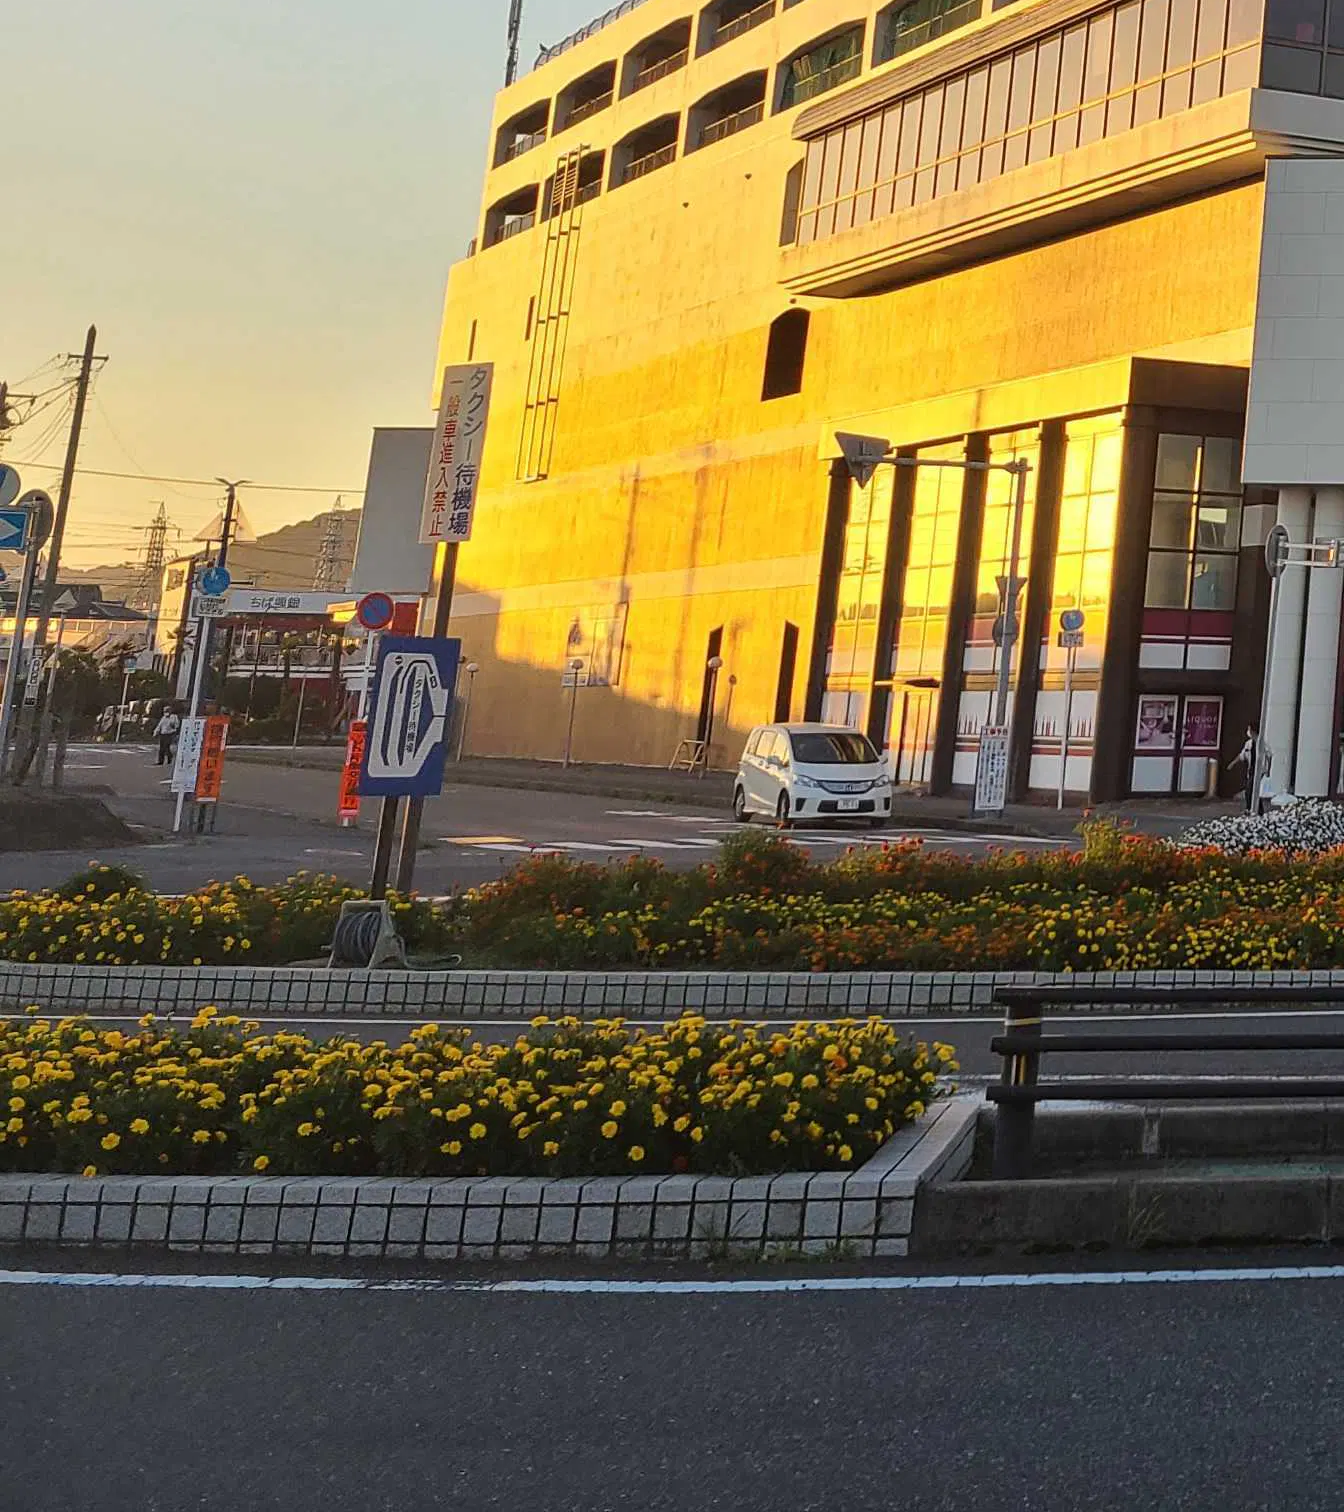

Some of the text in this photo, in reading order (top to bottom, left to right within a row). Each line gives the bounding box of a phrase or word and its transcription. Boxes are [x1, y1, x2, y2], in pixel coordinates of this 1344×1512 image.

[428, 380, 464, 536] 一般車進入禁止
[448, 367, 487, 535] タクシー待機場
